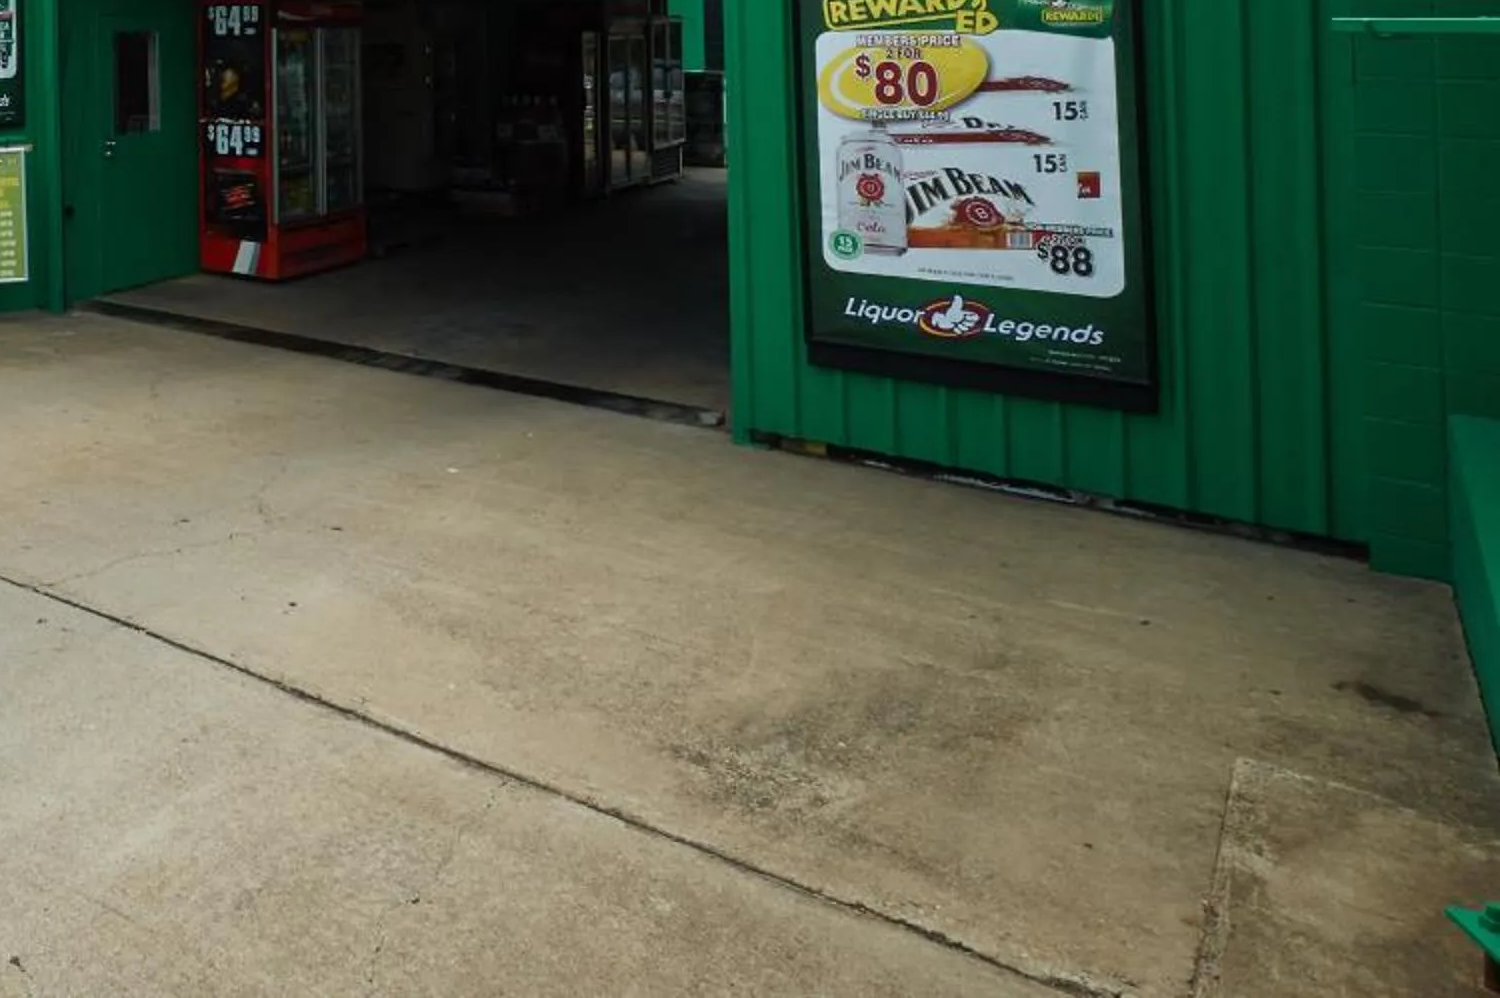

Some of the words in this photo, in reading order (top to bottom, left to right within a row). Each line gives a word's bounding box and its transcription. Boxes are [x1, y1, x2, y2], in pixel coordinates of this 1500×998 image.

[955, 10, 998, 36] ED
[855, 54, 938, 106] $80
[942, 167, 1035, 206] BEAM
[1037, 242, 1093, 276] $88
[844, 297, 925, 324] Liquor
[982, 312, 1104, 345] Legends
